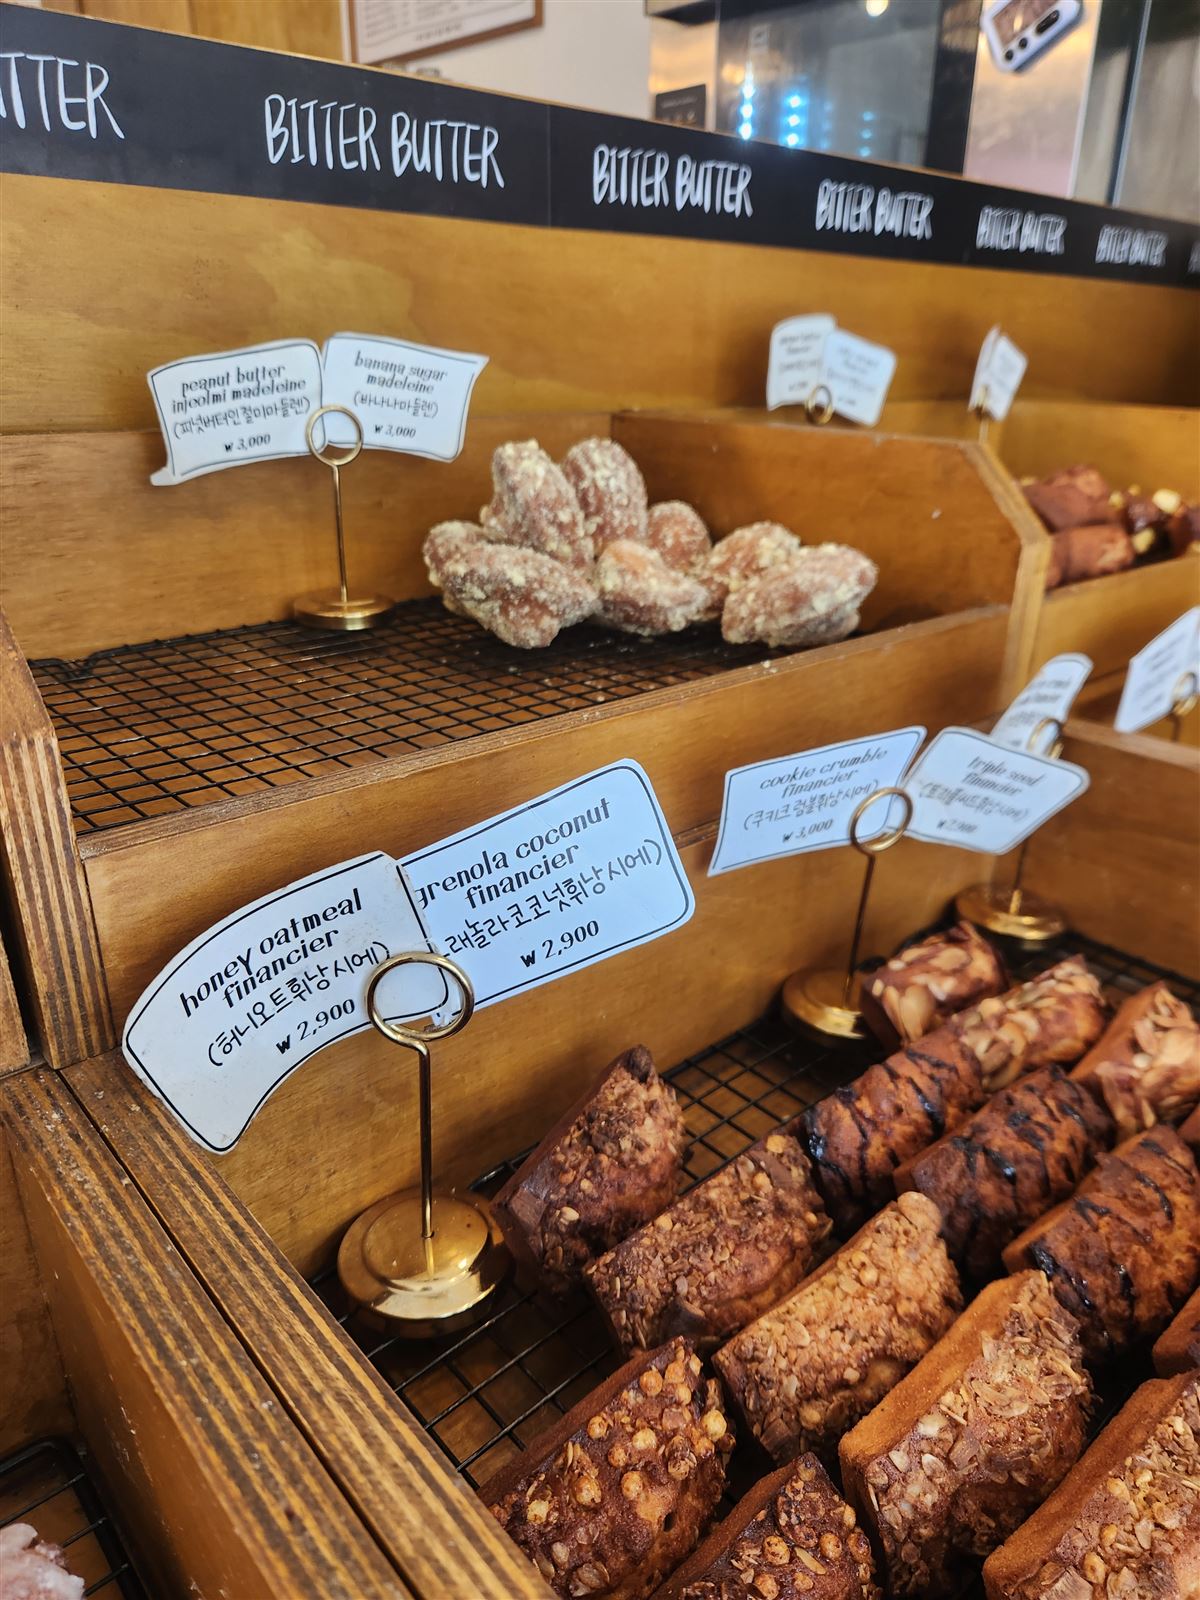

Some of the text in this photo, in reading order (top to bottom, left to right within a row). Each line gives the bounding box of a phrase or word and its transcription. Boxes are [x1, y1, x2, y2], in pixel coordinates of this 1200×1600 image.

[0, 52, 125, 139] TTER
[265, 93, 505, 189] BITTER BUTTER
[592, 143, 754, 218] BITTER BUTTER
[815, 178, 935, 241] BITTER BUTTER
[181, 366, 286, 398] peanut butter
[354, 350, 448, 382] banana sugar
[366, 373, 434, 394] madeleine
[172, 379, 307, 414] injeolmi madeleine
[236, 434, 272, 451] 3,000
[385, 424, 416, 438] 3,000
[760, 746, 888, 790] cookie crumble
[781, 769, 860, 799] financier
[796, 818, 834, 839] 3,000
[414, 798, 611, 910] grenola coconut
[443, 838, 662, 958] 래놀라코코넛휘낭시에)
[465, 844, 579, 910] financier
[179, 887, 362, 1018] honey oatmeal
[542, 920, 600, 960] 2,900
[222, 929, 339, 1009] financier
[208, 941, 390, 1066] (허니오트휘낭시에)
[296, 999, 355, 1041] 2,900
